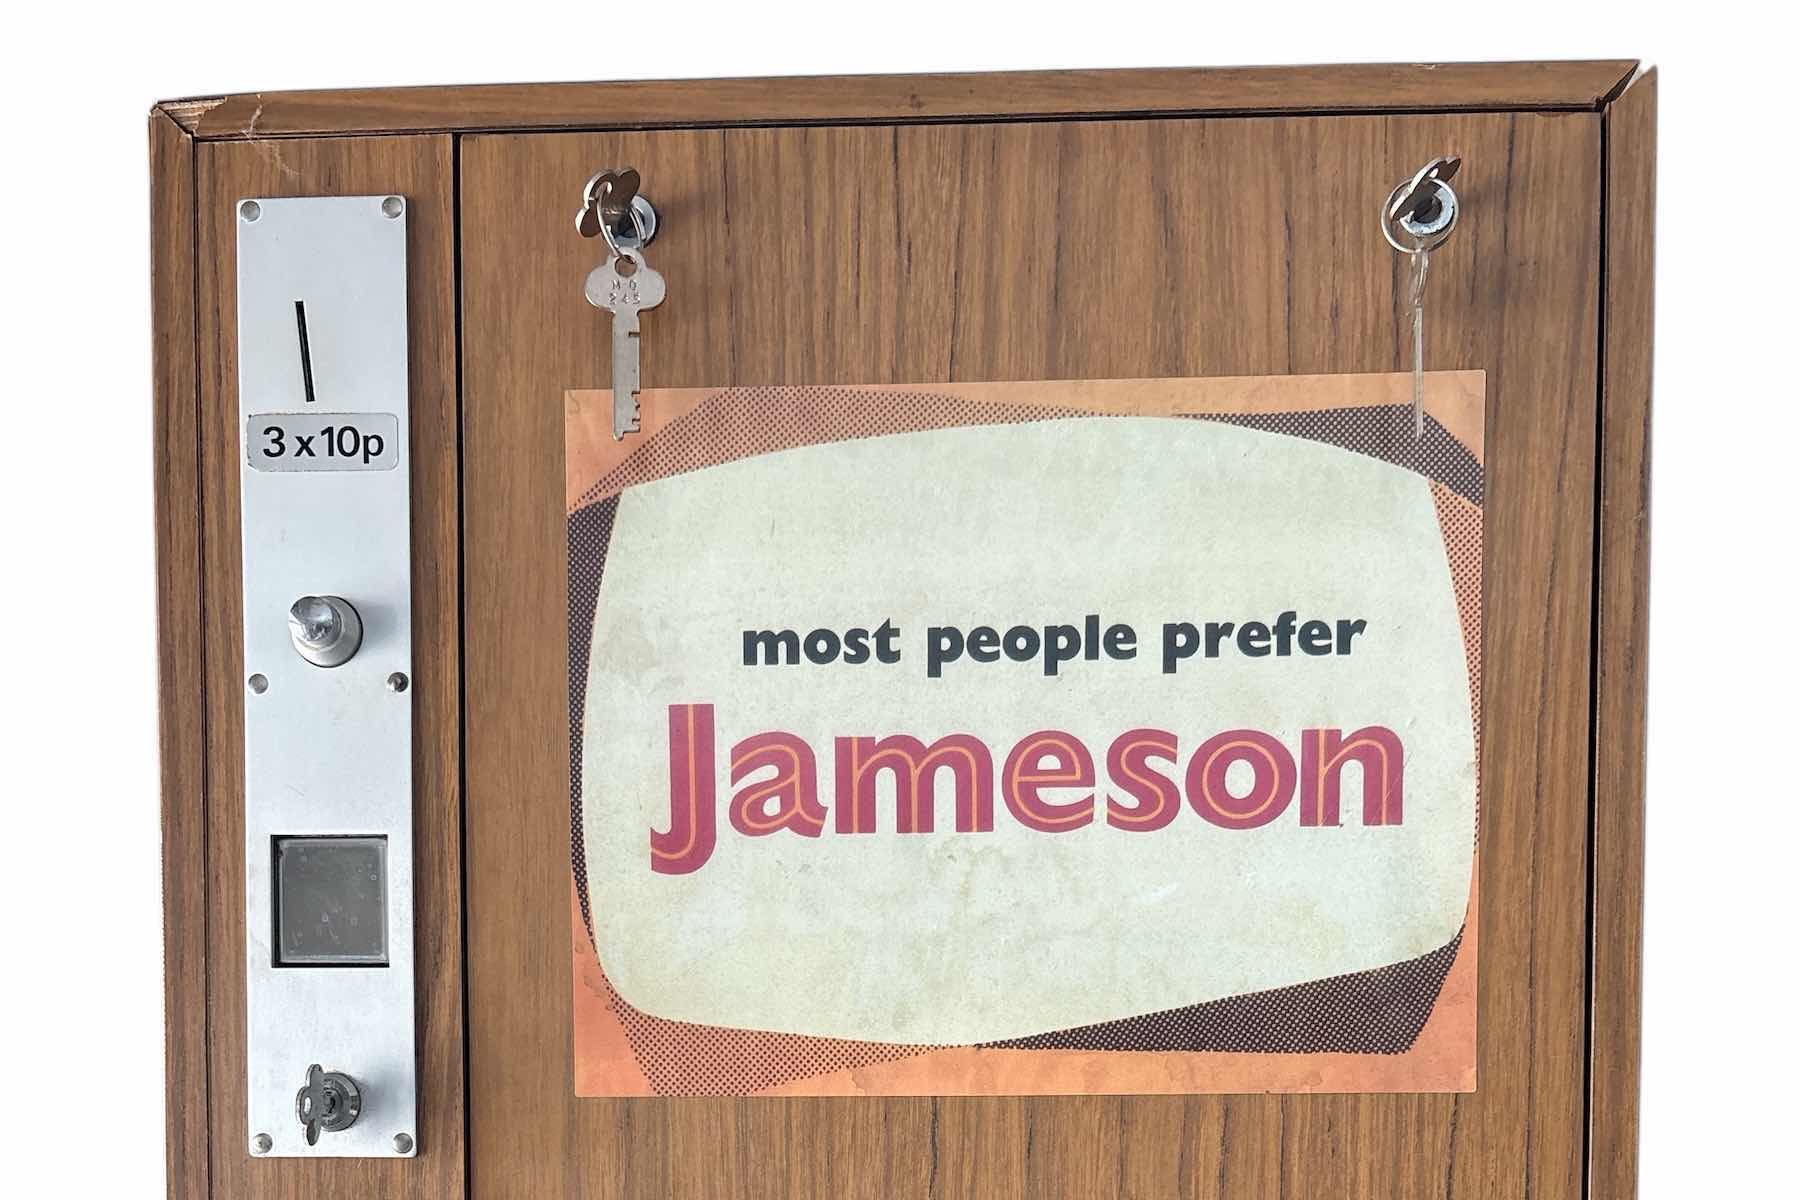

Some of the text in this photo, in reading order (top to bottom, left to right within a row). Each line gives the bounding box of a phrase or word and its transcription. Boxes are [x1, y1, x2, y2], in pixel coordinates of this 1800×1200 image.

[263, 426, 286, 457] 3
[742, 610, 1368, 679] most people prefer
[649, 703, 1406, 876] Jameson
